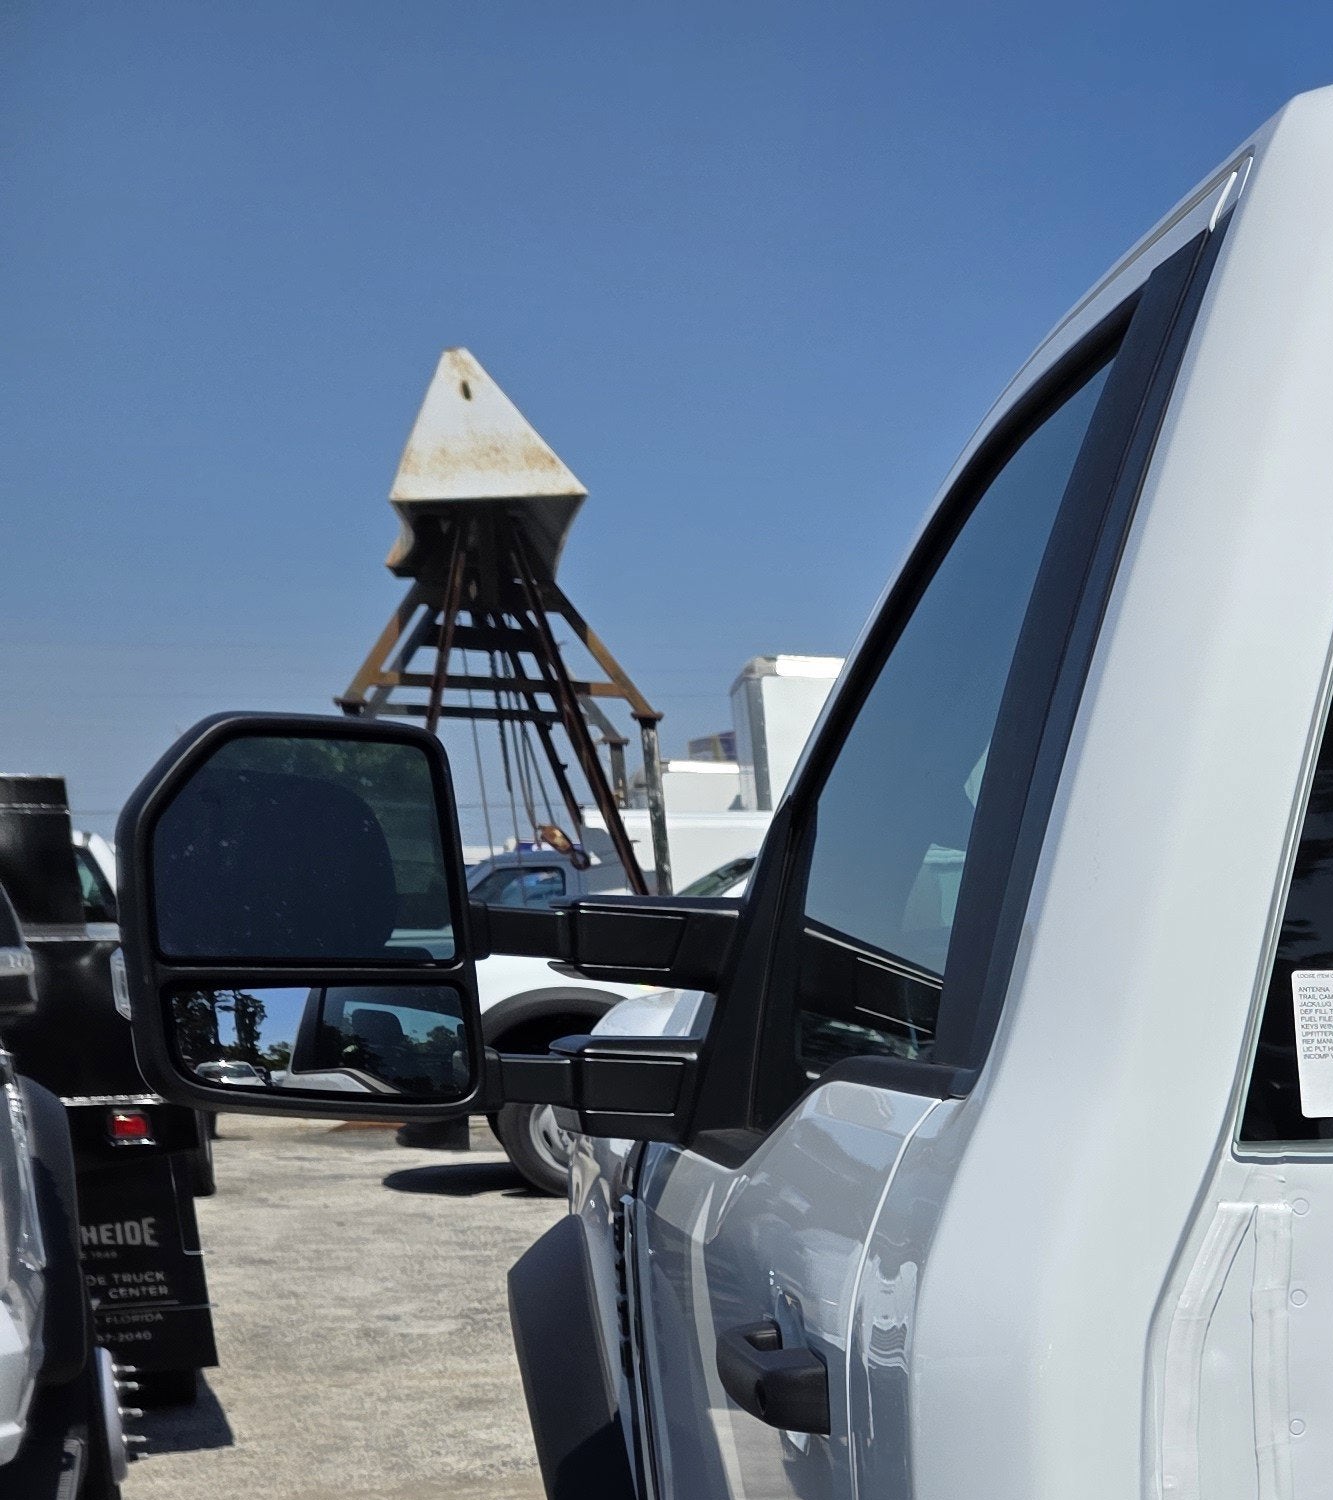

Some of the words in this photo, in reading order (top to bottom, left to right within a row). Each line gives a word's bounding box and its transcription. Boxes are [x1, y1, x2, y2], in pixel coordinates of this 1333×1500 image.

[80, 1217, 159, 1247] HEIDE
[112, 1271, 165, 1284] TRUCK
[108, 1285, 169, 1299] CENTER
[105, 1312, 164, 1323] FLORIDA
